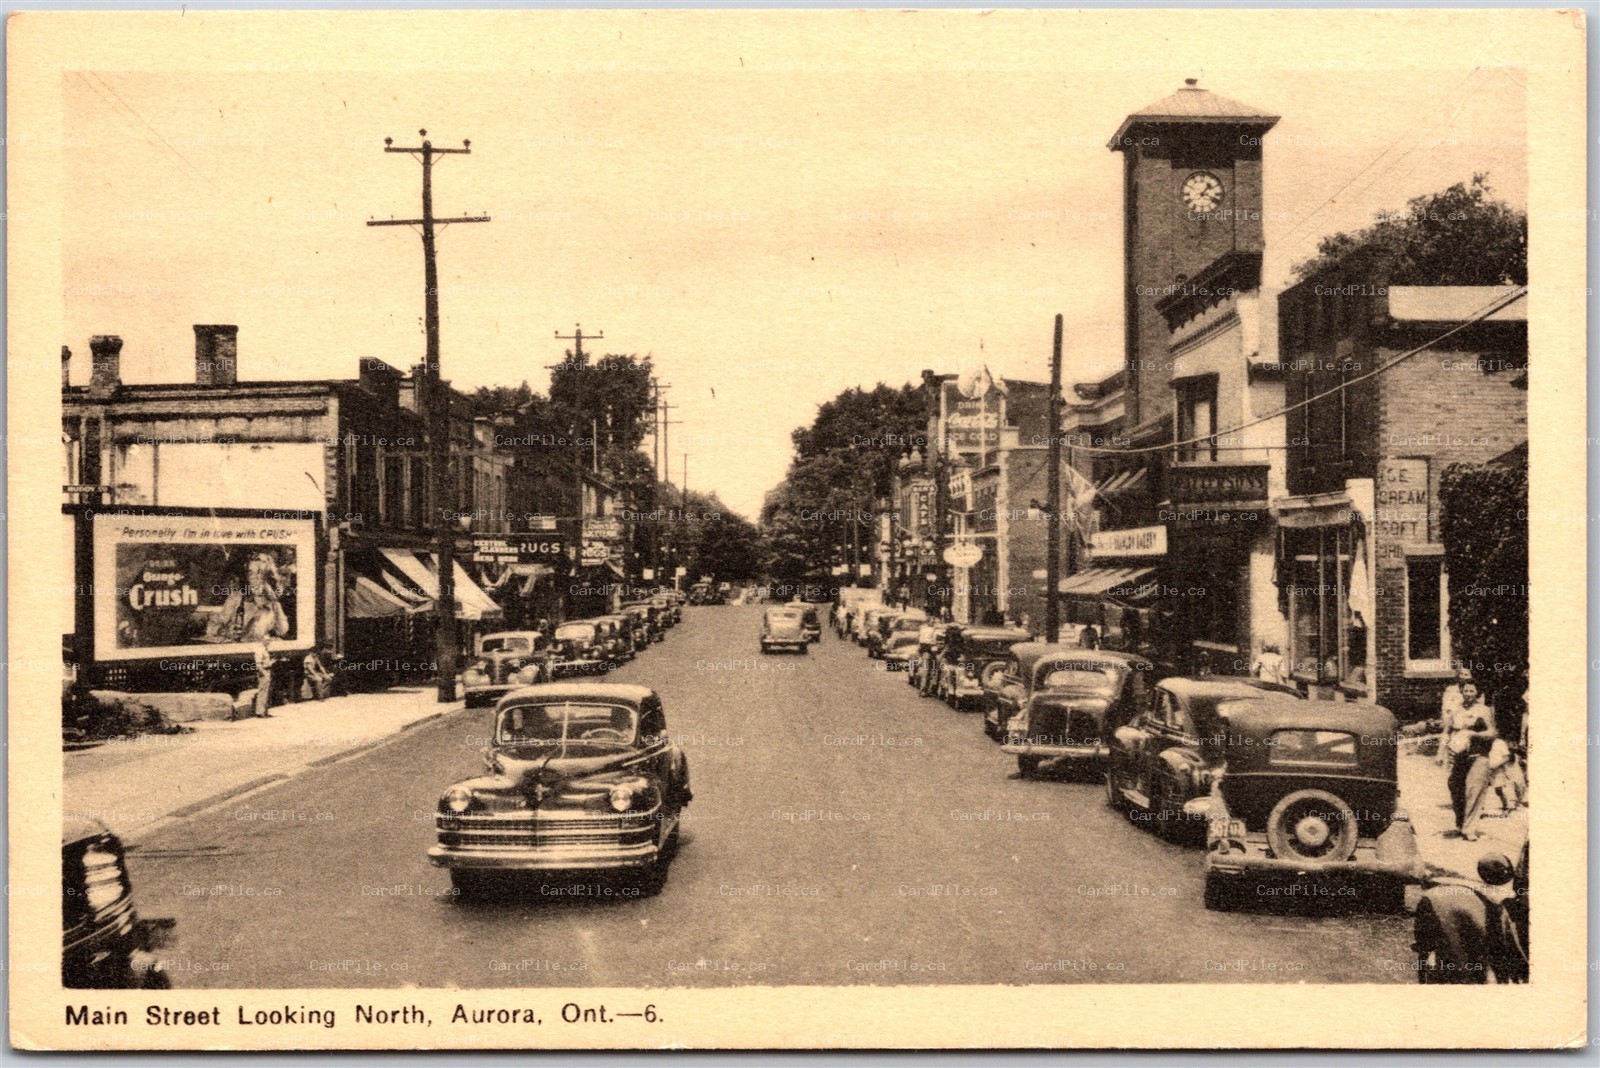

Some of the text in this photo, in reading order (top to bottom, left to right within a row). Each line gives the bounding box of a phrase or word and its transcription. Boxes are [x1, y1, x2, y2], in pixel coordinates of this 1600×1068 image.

[1379, 490, 1427, 505] CREAM
[1380, 521, 1418, 536] SOFT
[129, 584, 198, 611] Crush
